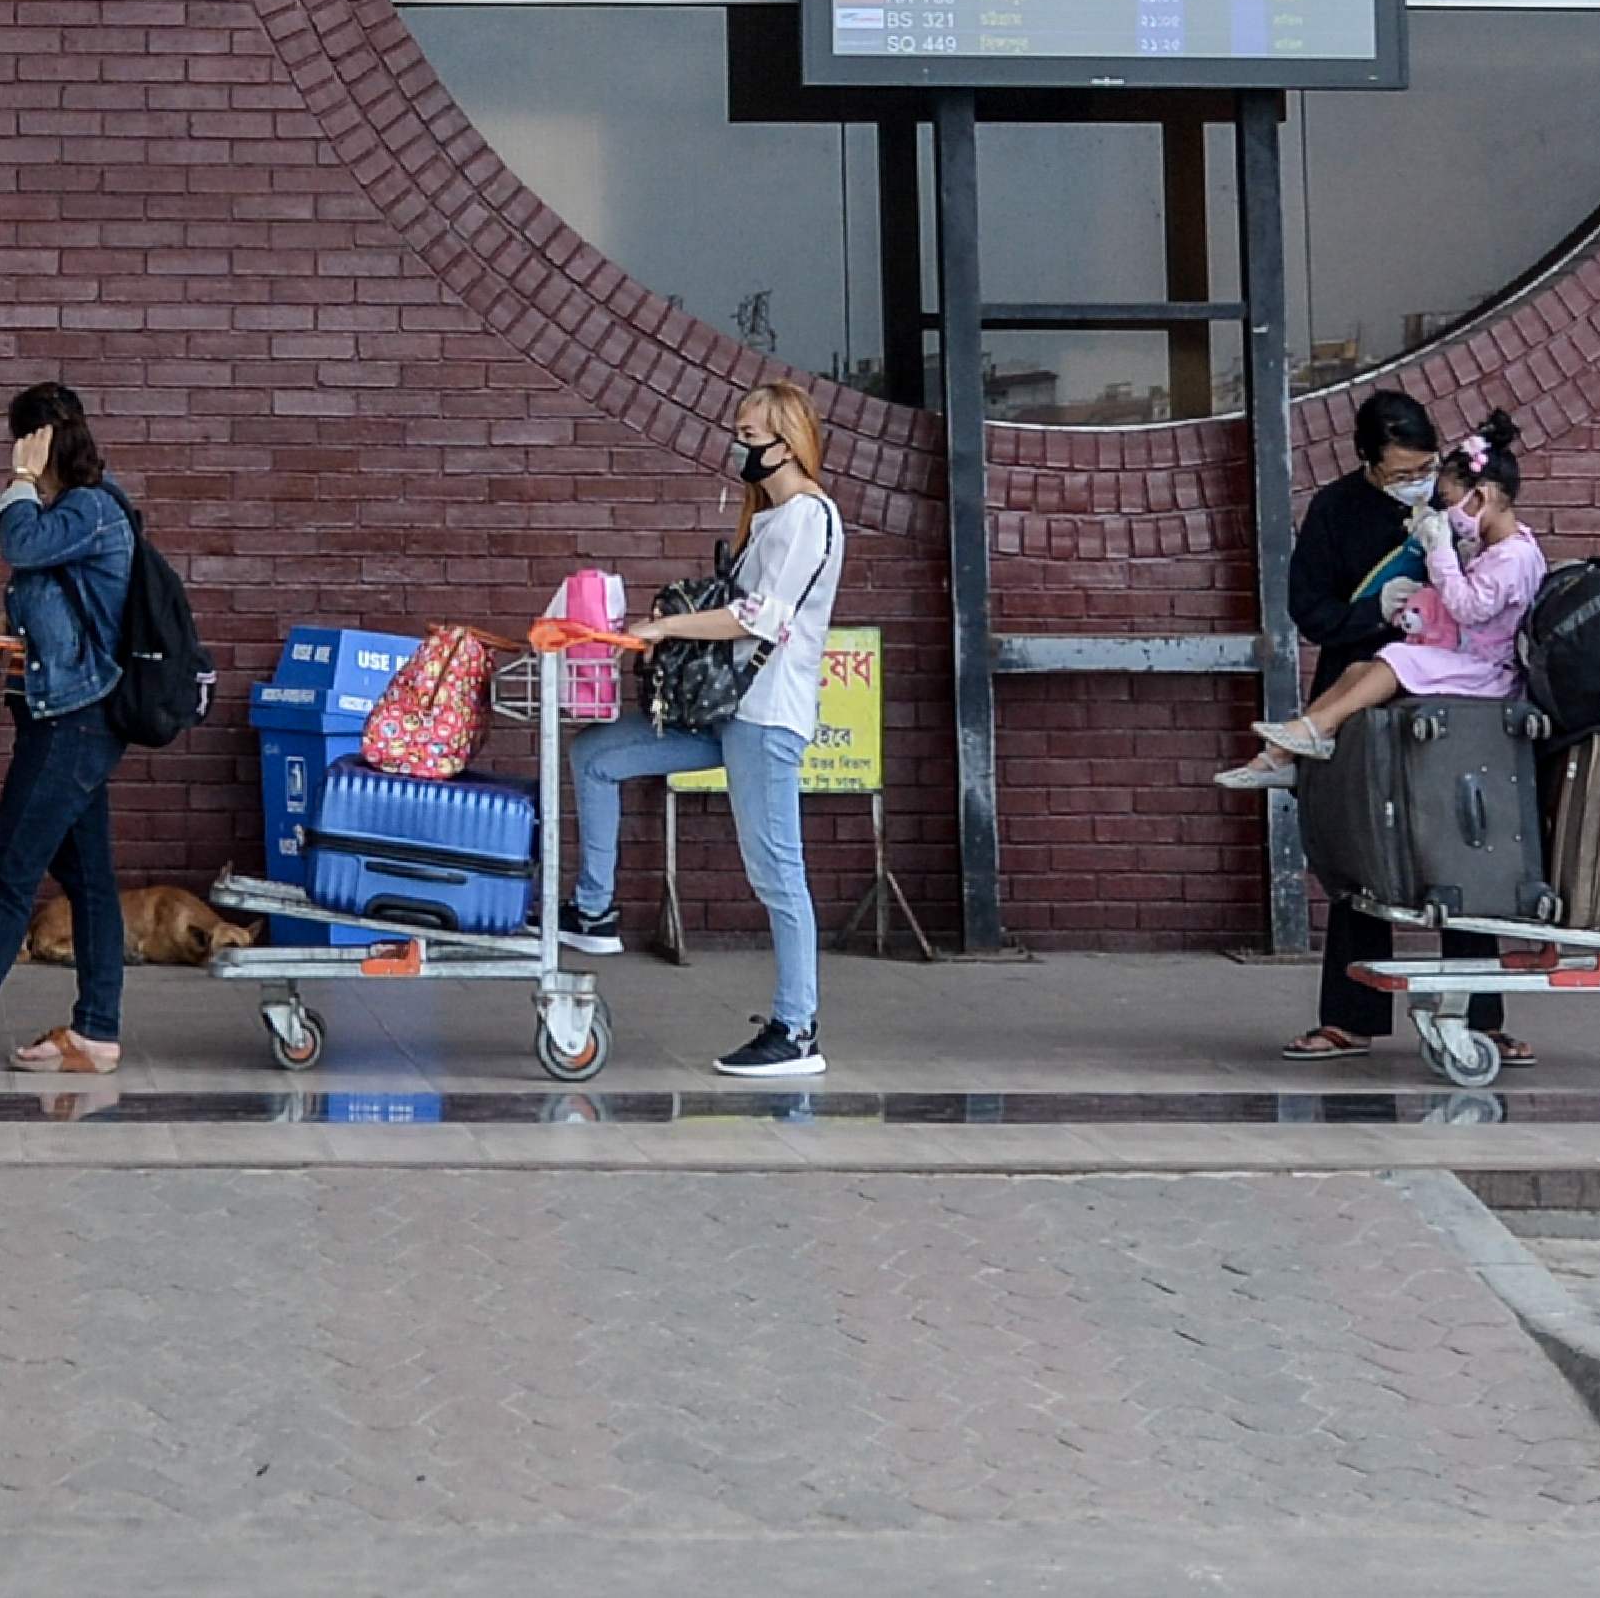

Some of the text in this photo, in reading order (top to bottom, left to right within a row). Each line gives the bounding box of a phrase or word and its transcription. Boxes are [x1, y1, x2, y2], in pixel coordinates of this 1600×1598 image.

[887, 11, 914, 28] BS
[922, 11, 955, 28] 321
[887, 35, 916, 52] SQ
[922, 35, 957, 52] 449
[356, 649, 390, 671] USE
